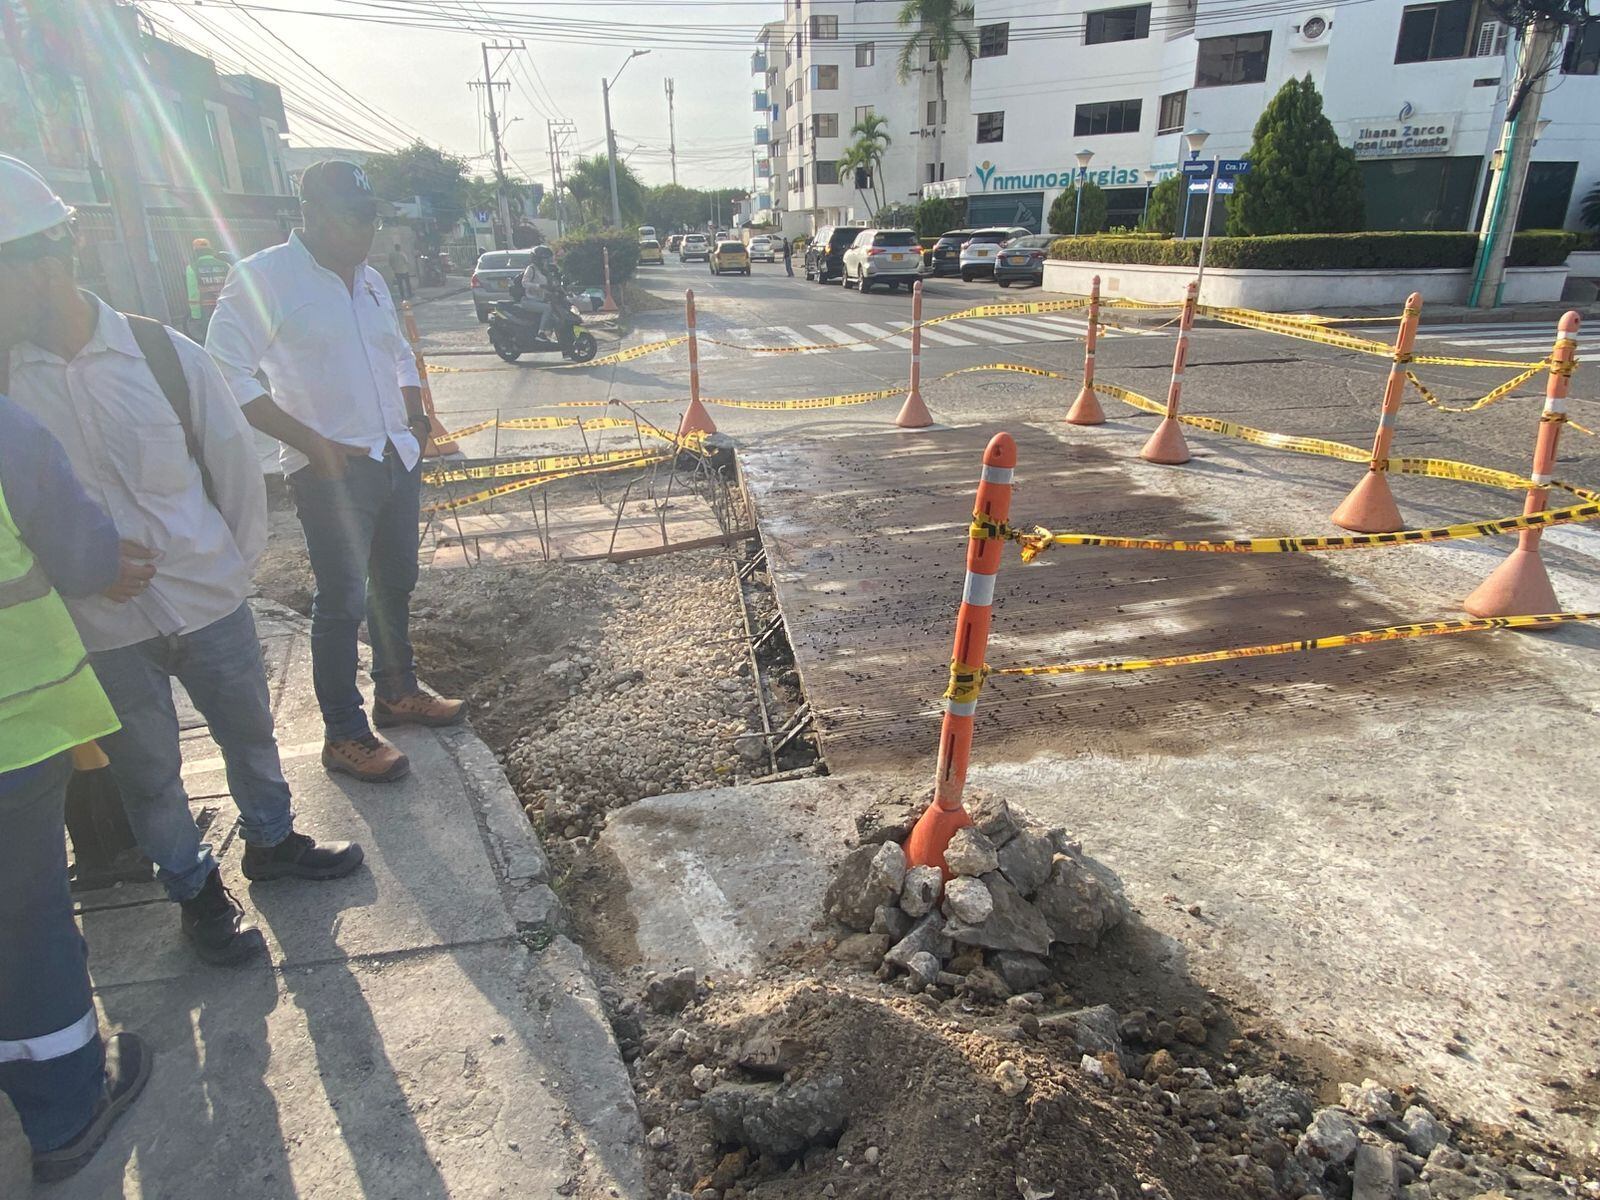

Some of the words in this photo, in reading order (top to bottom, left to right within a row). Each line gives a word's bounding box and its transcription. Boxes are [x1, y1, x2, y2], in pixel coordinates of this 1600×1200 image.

[1402, 125, 1445, 137] Zarco
[1404, 136, 1448, 148] Cuesta
[1239, 162, 1248, 170] 17
